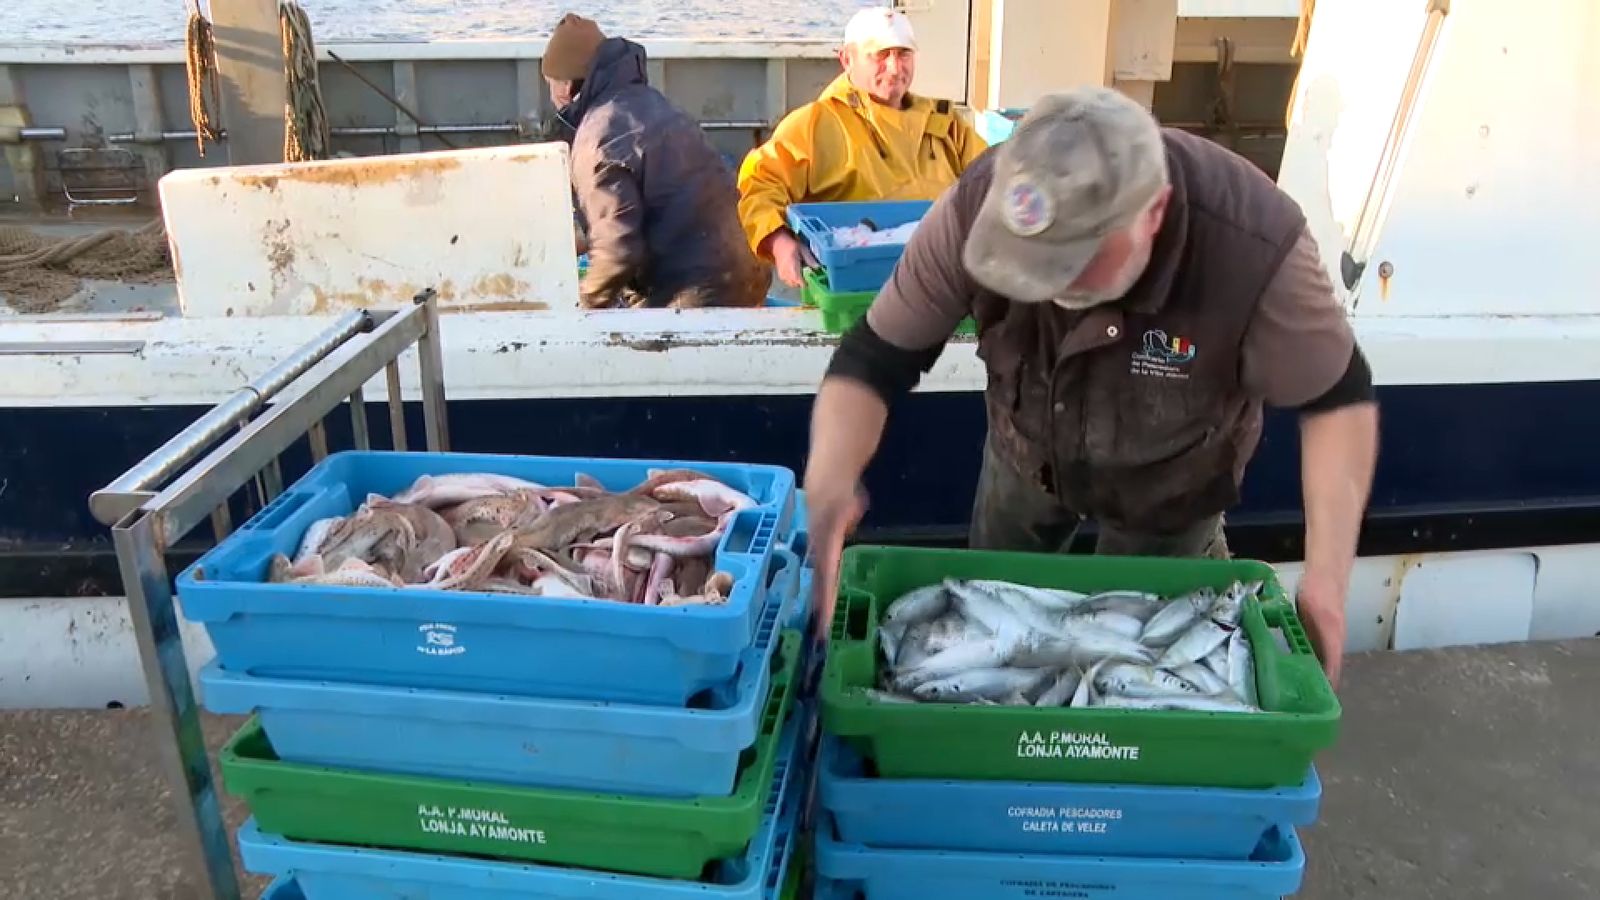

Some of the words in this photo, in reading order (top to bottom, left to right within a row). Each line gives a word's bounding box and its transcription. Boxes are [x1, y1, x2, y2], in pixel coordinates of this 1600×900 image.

[1017, 744, 1062, 758] LONJA
[1064, 745, 1140, 760] AYAMONTE
[1060, 808, 1123, 819] PESCADORES
[421, 818, 467, 836] LONJA
[469, 823, 547, 844] AYAMONTE
[1023, 821, 1059, 832] CALETA
[1061, 821, 1074, 832] DE
[1077, 822, 1108, 833] VELEZ
